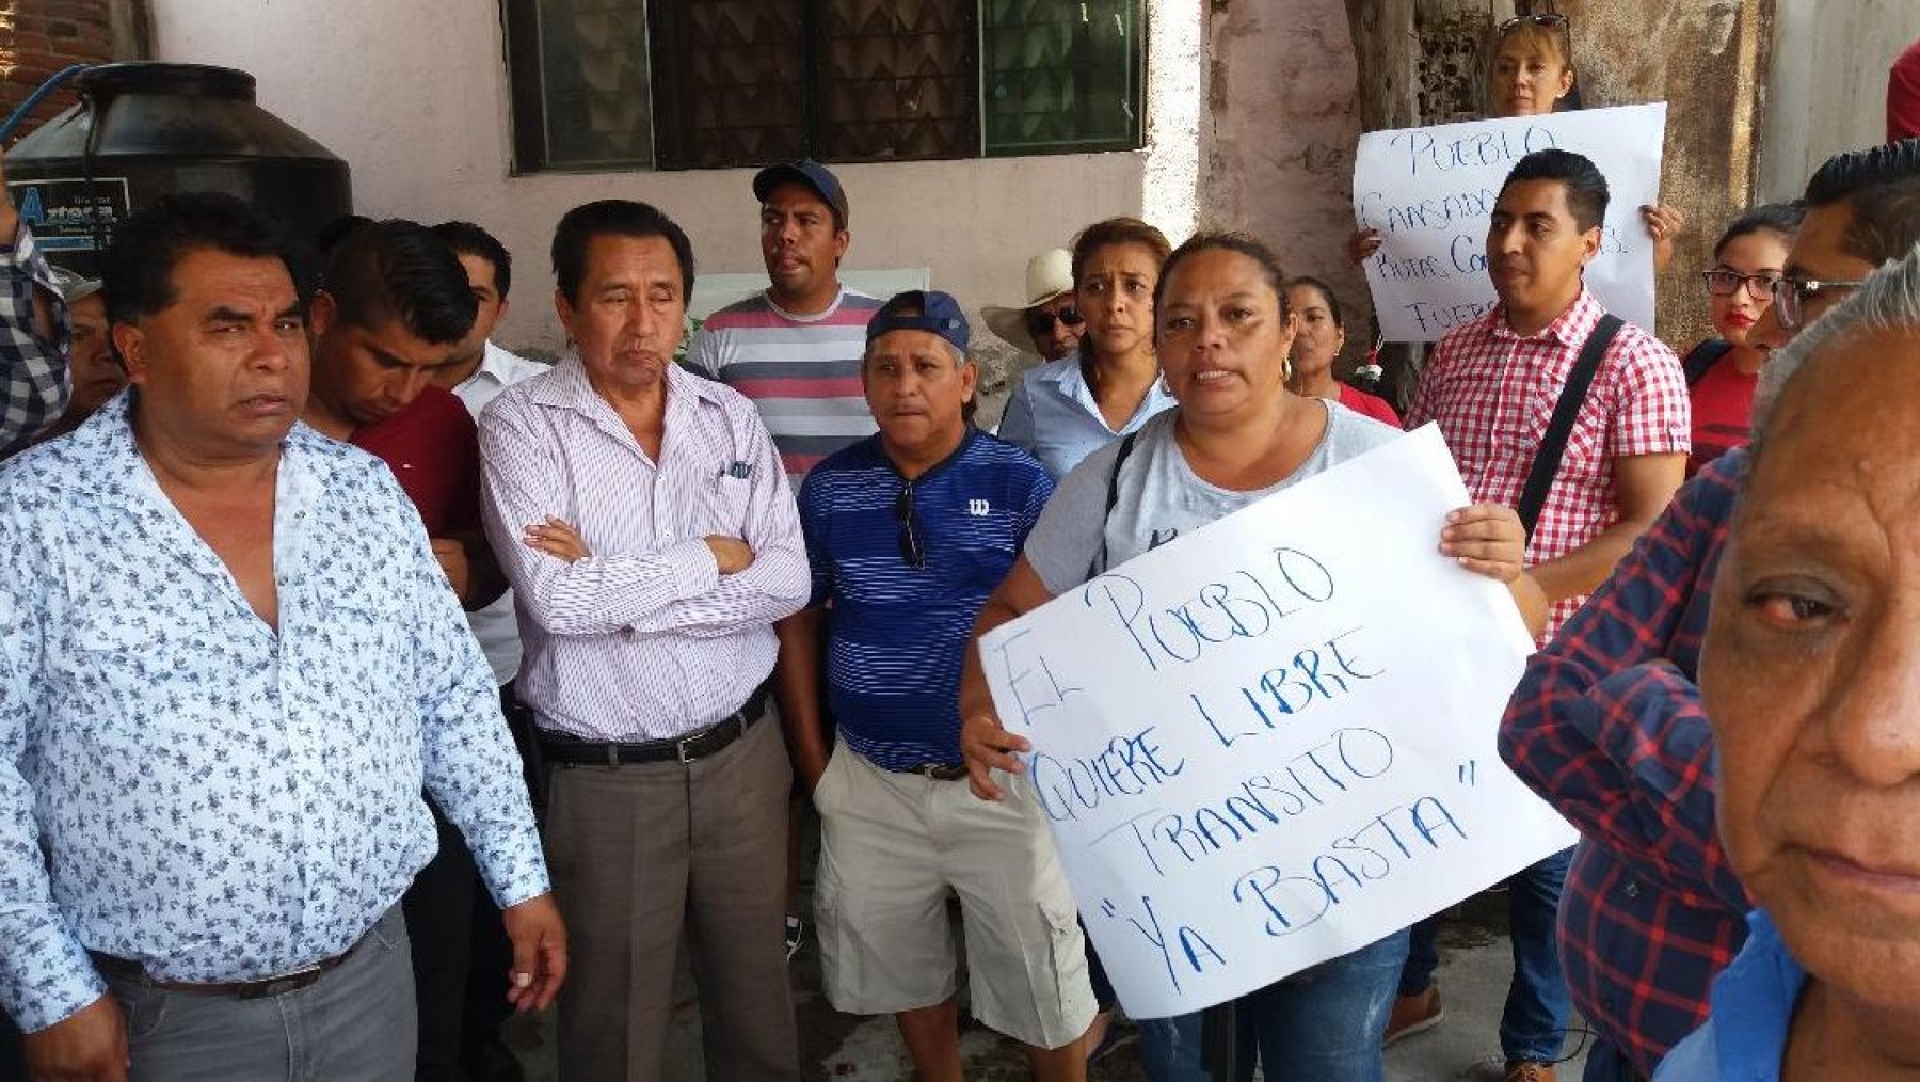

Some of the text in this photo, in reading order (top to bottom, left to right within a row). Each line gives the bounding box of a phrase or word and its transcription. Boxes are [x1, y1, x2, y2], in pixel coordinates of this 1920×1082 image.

[1390, 124, 1557, 176] PUEBLO
[1000, 545, 1334, 726] EL PUEBLO
[1033, 626, 1386, 822] QUIERE LIBRE
[1088, 726, 1393, 876] TRANSITO
